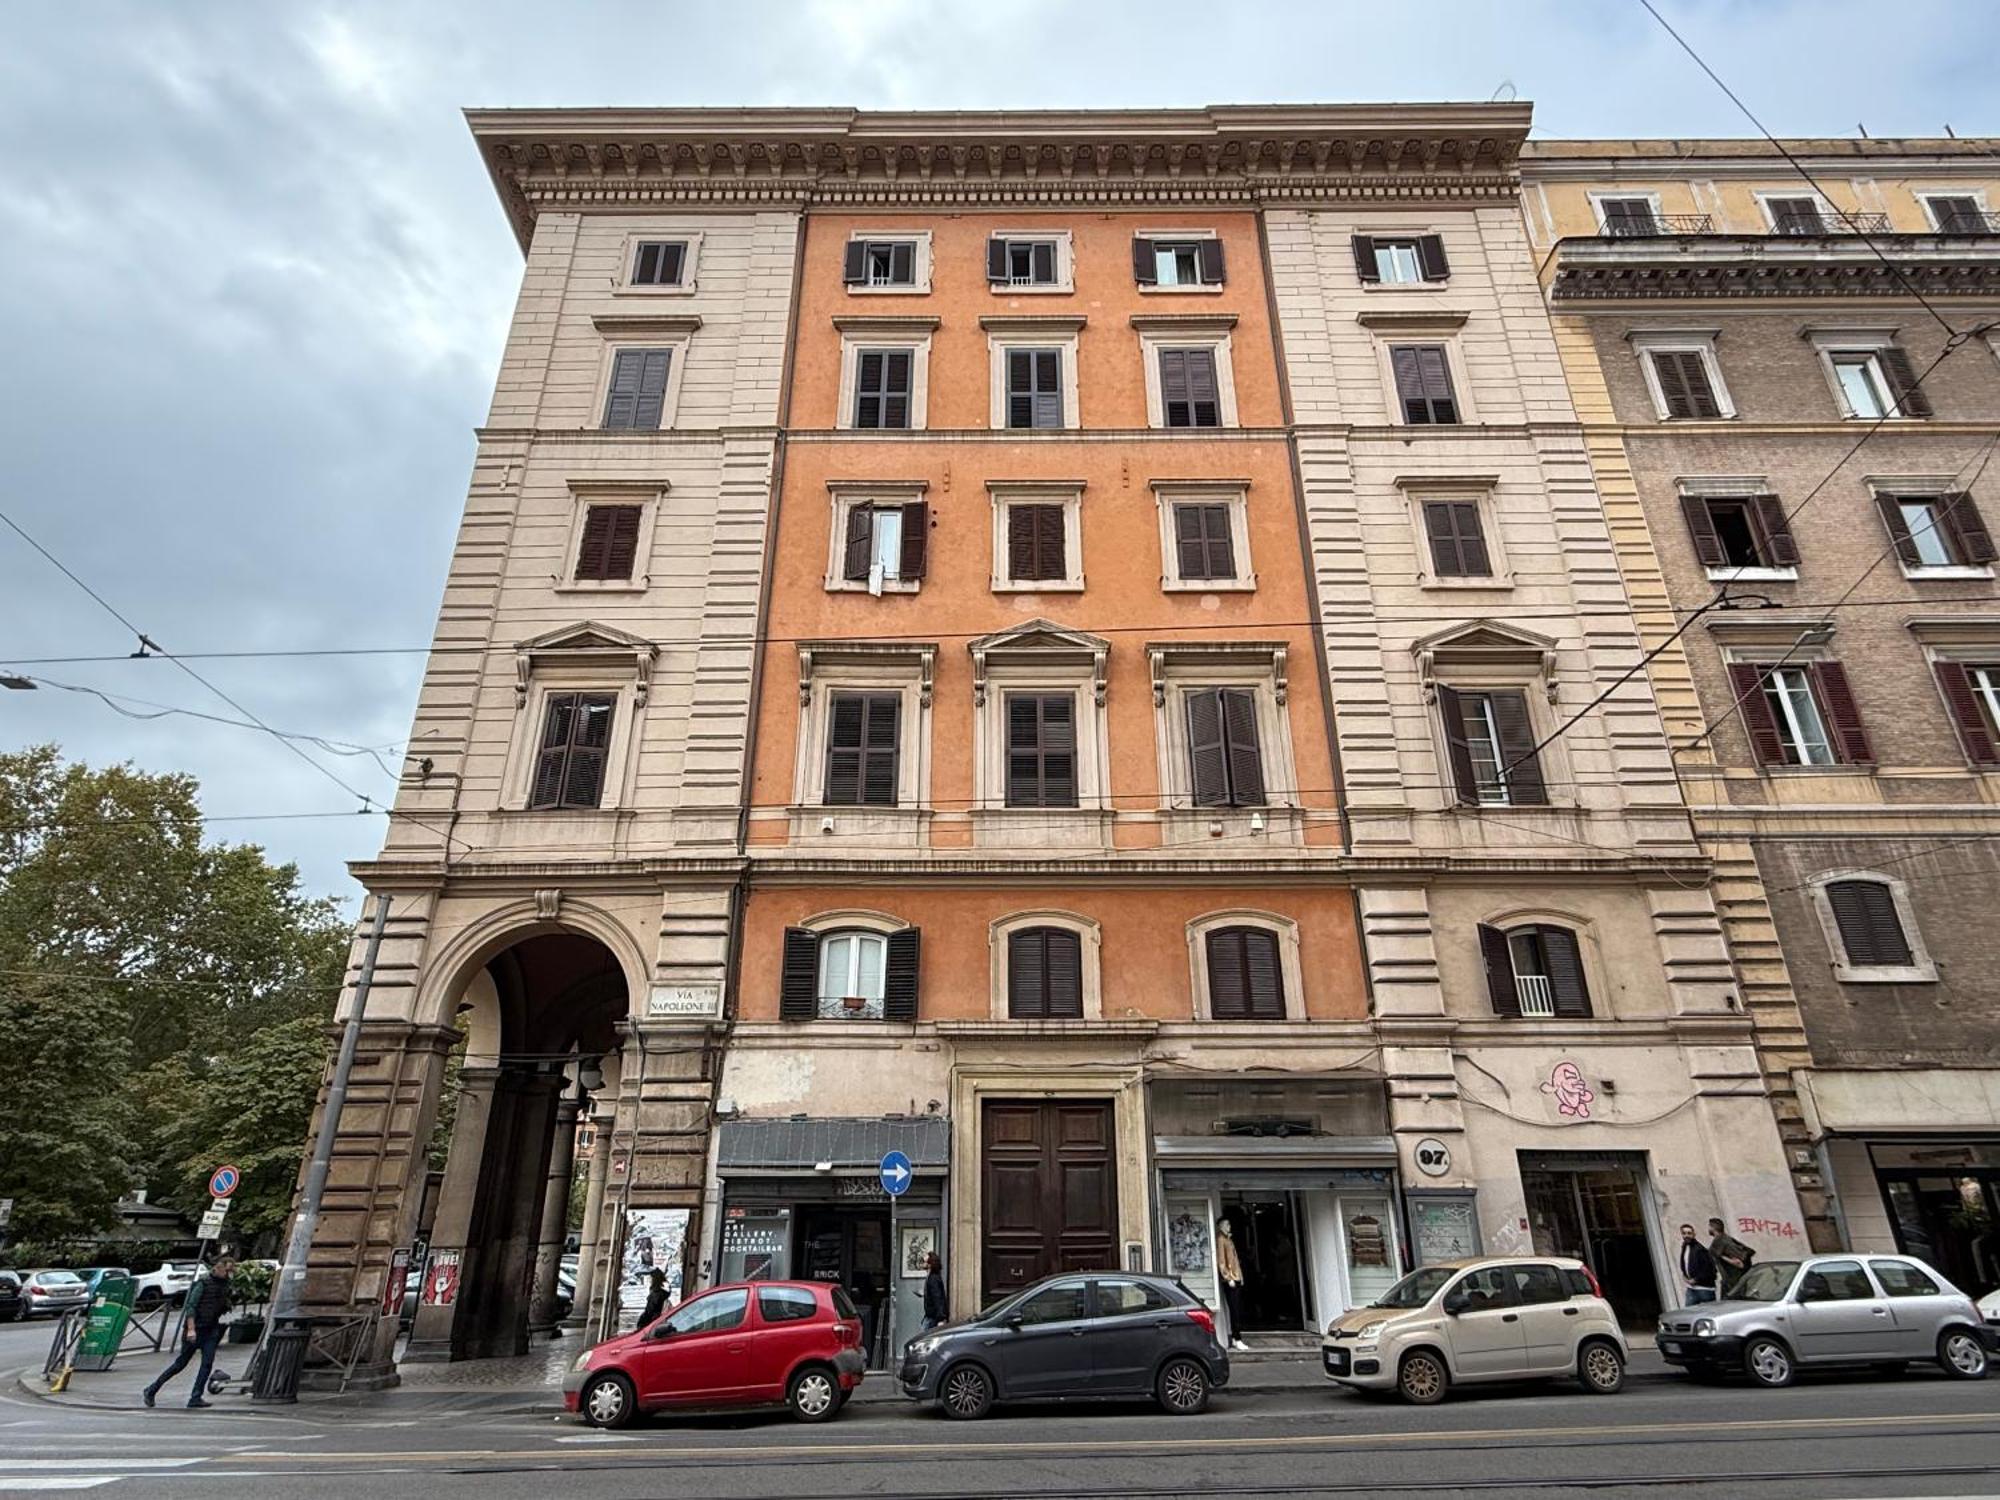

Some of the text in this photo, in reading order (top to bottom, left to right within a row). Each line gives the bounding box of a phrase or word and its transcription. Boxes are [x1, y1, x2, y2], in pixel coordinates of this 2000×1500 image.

[676, 991, 693, 1000] VIA
[651, 1002, 704, 1011] NAPOLEONE
[724, 1223, 745, 1231] ART
[803, 1240, 821, 1249] THE
[814, 1269, 840, 1279] BRICK
